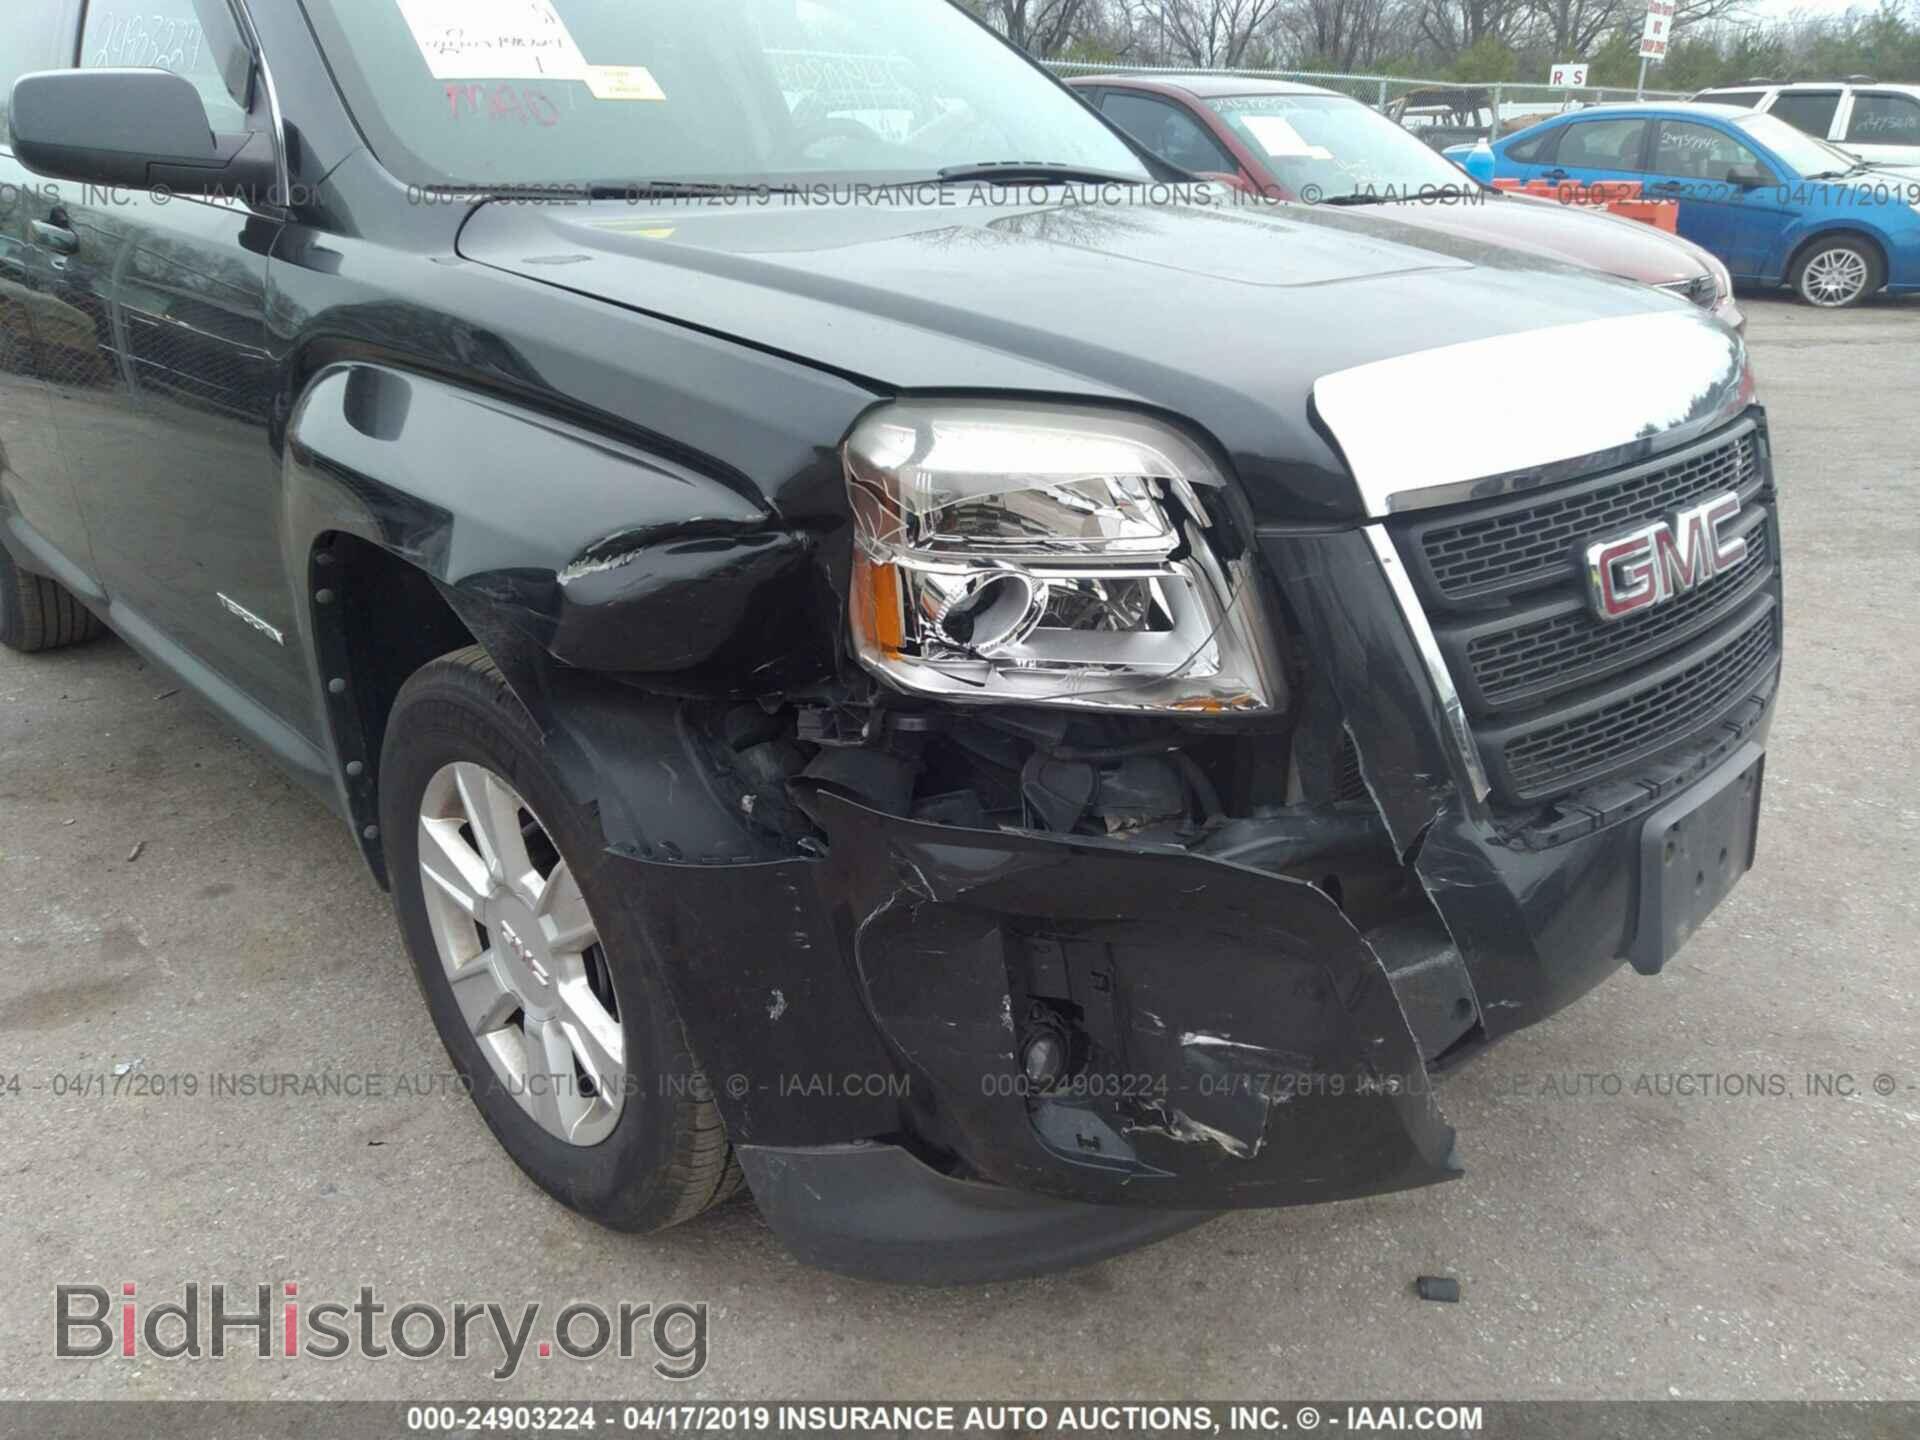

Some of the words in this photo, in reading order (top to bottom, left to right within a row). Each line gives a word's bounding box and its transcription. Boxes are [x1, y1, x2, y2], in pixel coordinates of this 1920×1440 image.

[1552, 70, 1563, 85] R
[1573, 70, 1583, 85] S
[1586, 490, 1748, 621] GMC
